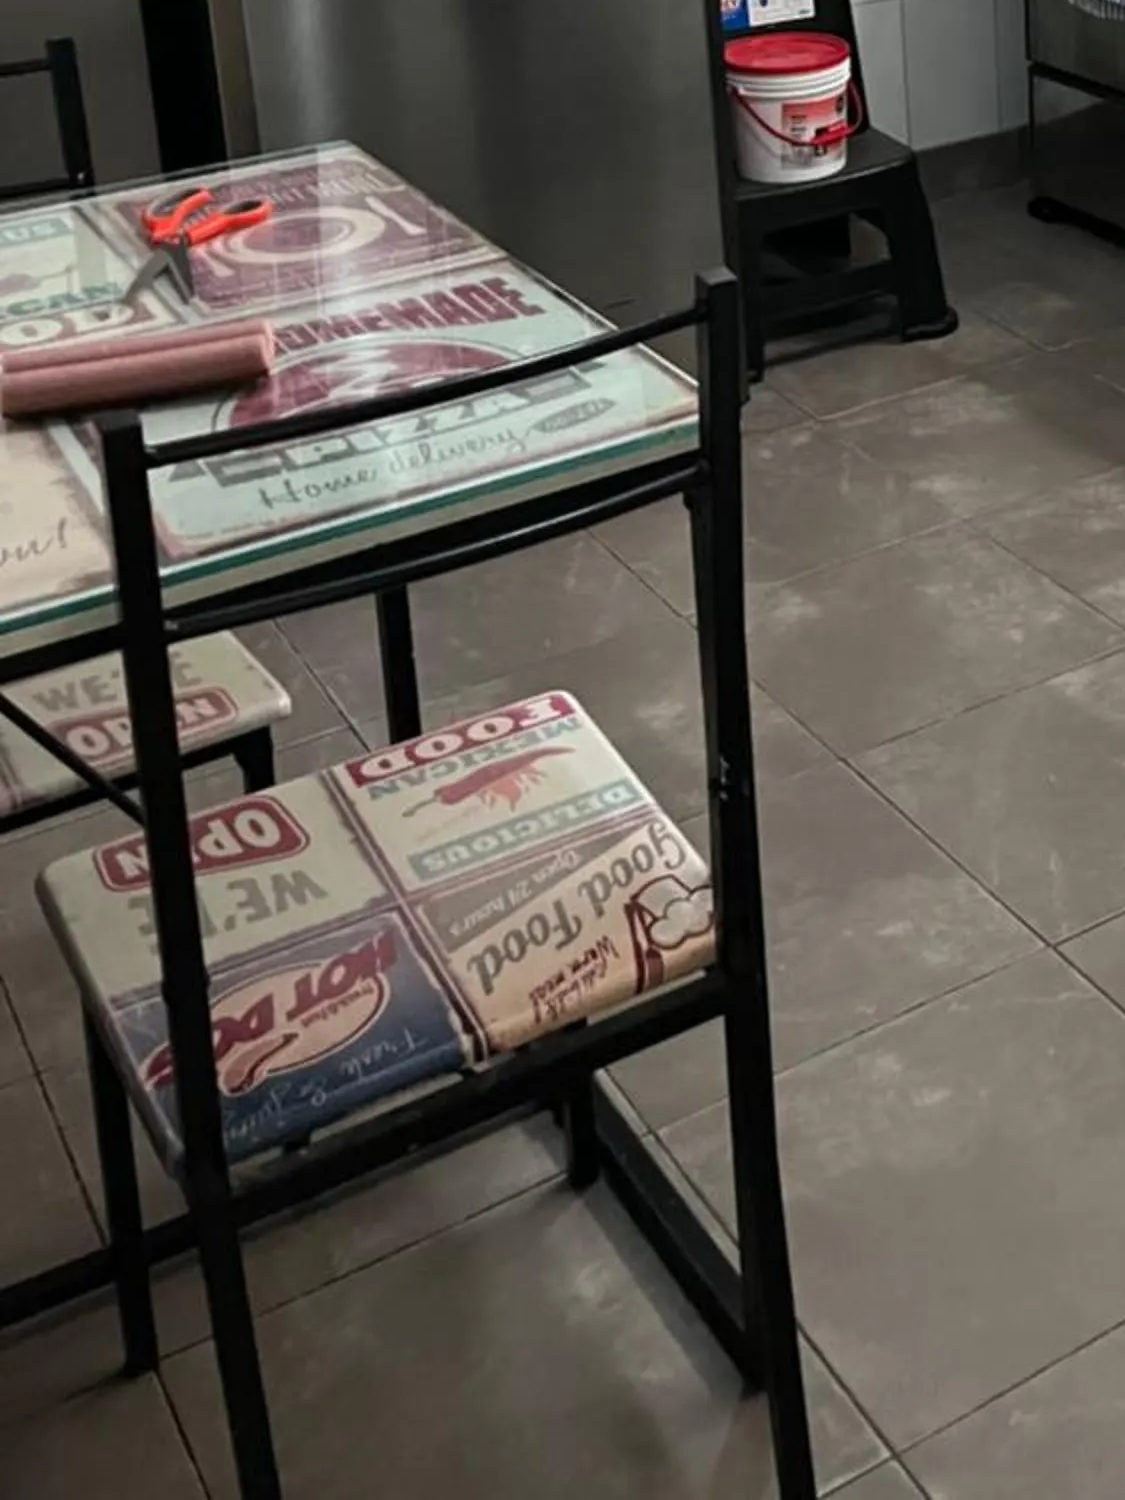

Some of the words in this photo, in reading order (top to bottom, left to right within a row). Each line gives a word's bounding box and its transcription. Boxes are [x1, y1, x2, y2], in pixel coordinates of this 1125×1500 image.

[274, 278, 547, 356] OMEMADE
[259, 467, 377, 510] Home
[65, 697, 221, 756] OPN
[359, 696, 563, 778] FOOD
[368, 716, 583, 800] MEXICAN
[115, 809, 281, 879] OPN
[421, 786, 637, 873] DELICIOUS
[577, 819, 686, 918] Good
[286, 927, 397, 1022] HOT
[466, 900, 584, 996] Food
